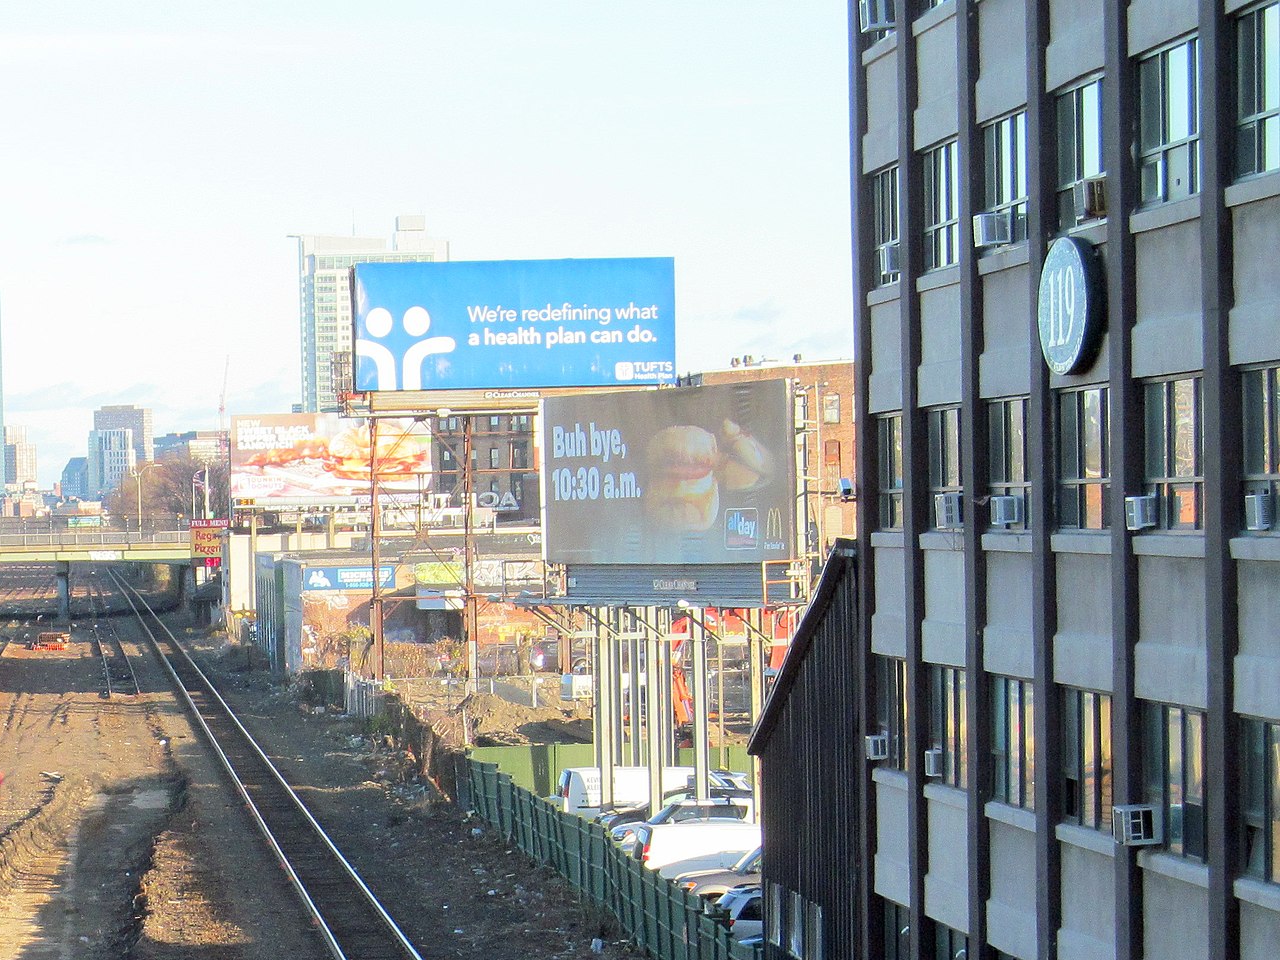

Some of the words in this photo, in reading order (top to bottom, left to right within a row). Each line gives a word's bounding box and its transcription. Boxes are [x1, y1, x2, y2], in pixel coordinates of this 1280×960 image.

[467, 304, 517, 323] We're
[522, 302, 611, 325] redefining
[615, 302, 658, 320] what
[1048, 265, 1075, 348] 119
[468, 333, 480, 346] a
[484, 326, 541, 346] health
[546, 326, 586, 349] plan
[590, 329, 623, 344] can
[627, 325, 657, 344] do.
[634, 361, 673, 372] TUFTS
[552, 423, 587, 458] Buh
[589, 422, 627, 462] bye,
[552, 466, 600, 501] 10:30
[603, 472, 641, 499] a.m.
